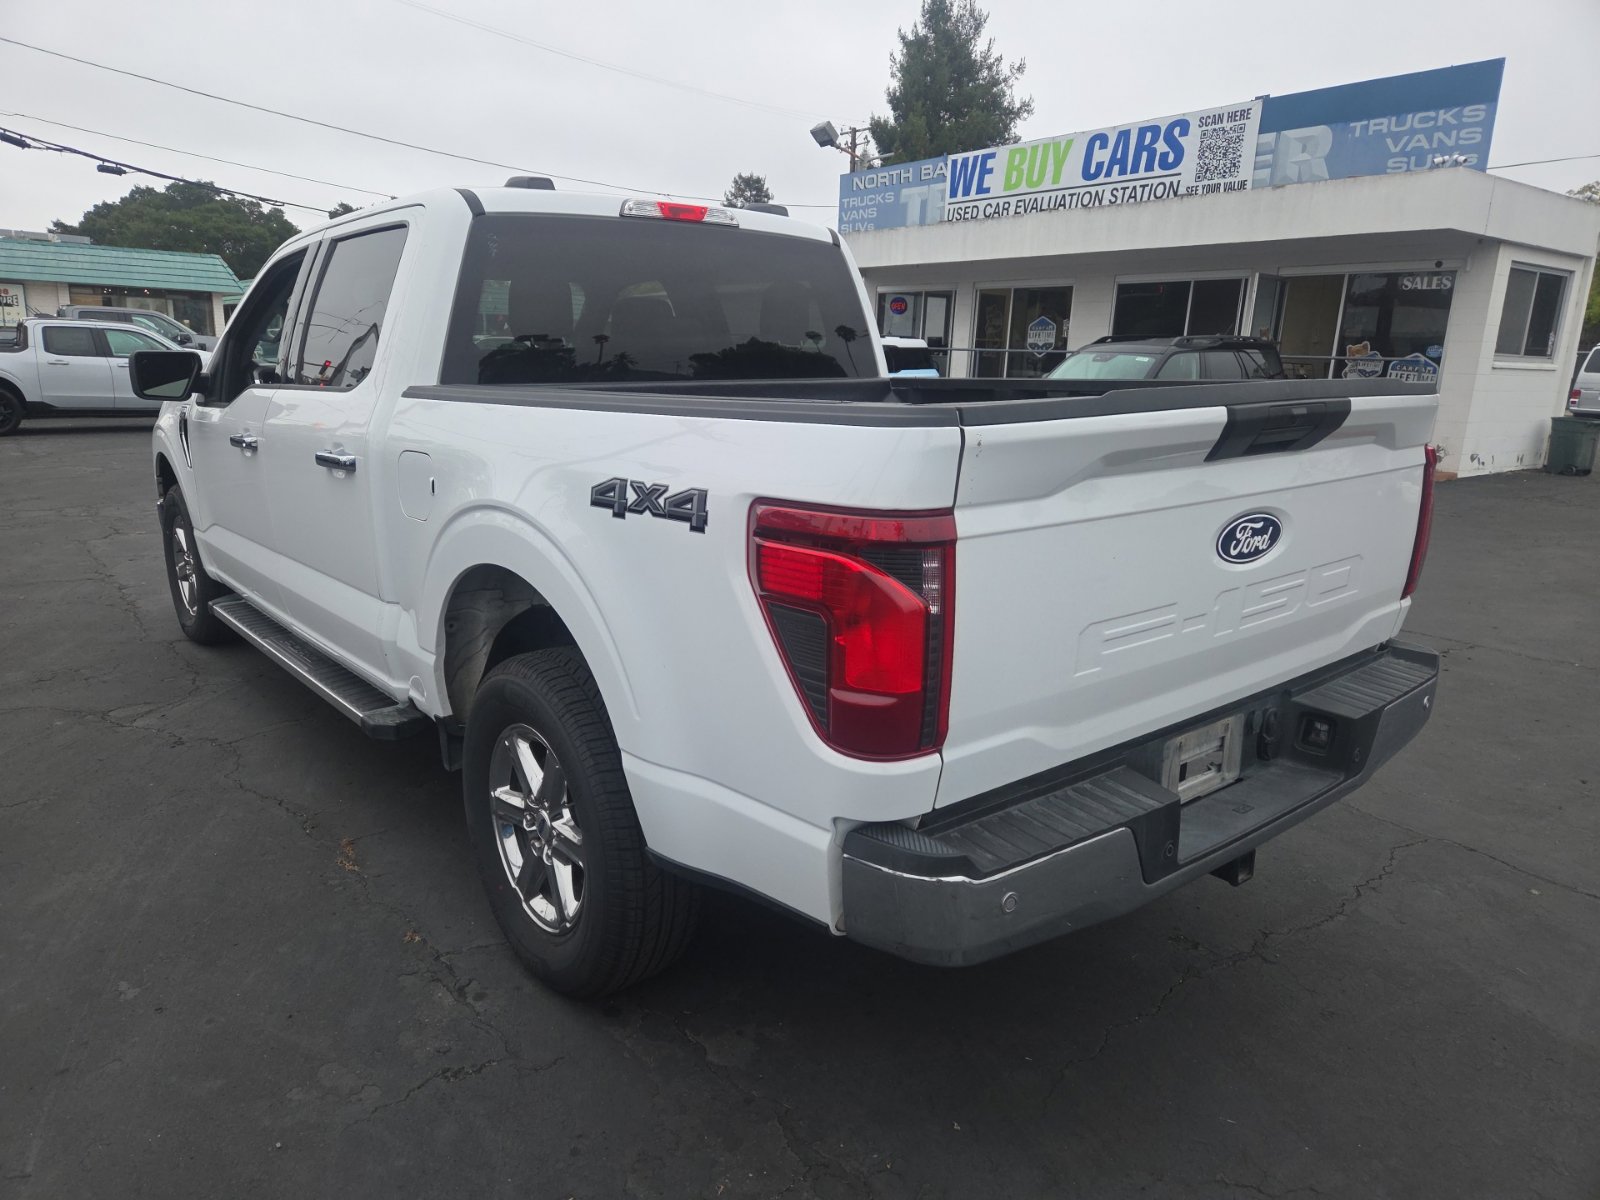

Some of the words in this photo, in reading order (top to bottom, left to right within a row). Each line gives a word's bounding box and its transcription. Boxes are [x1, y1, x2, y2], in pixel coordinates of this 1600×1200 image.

[1198, 112, 1224, 128] SCAN
[1226, 108, 1252, 123] HERE
[1350, 104, 1487, 138] TRUCKS
[1385, 127, 1483, 153] VANS
[949, 152, 997, 198] WE
[1003, 138, 1074, 192] BUY
[1081, 118, 1191, 181] CARS
[852, 167, 913, 191] NORTH
[920, 161, 947, 181] BA
[1185, 185, 1199, 196] SEE
[1201, 182, 1221, 194] YOUR
[1223, 179, 1248, 192] VALUE
[842, 192, 895, 208] TRUCKS
[947, 205, 979, 221] USED
[983, 201, 1011, 218] CAR
[1014, 189, 1105, 215] EVALUATION
[1108, 180, 1181, 204] STATION
[841, 207, 877, 221] VANS
[1402, 275, 1452, 290] SALES
[1389, 371, 1437, 382] LIFETME
[1230, 520, 1274, 556] Ford
[1073, 553, 1365, 678] F-150
